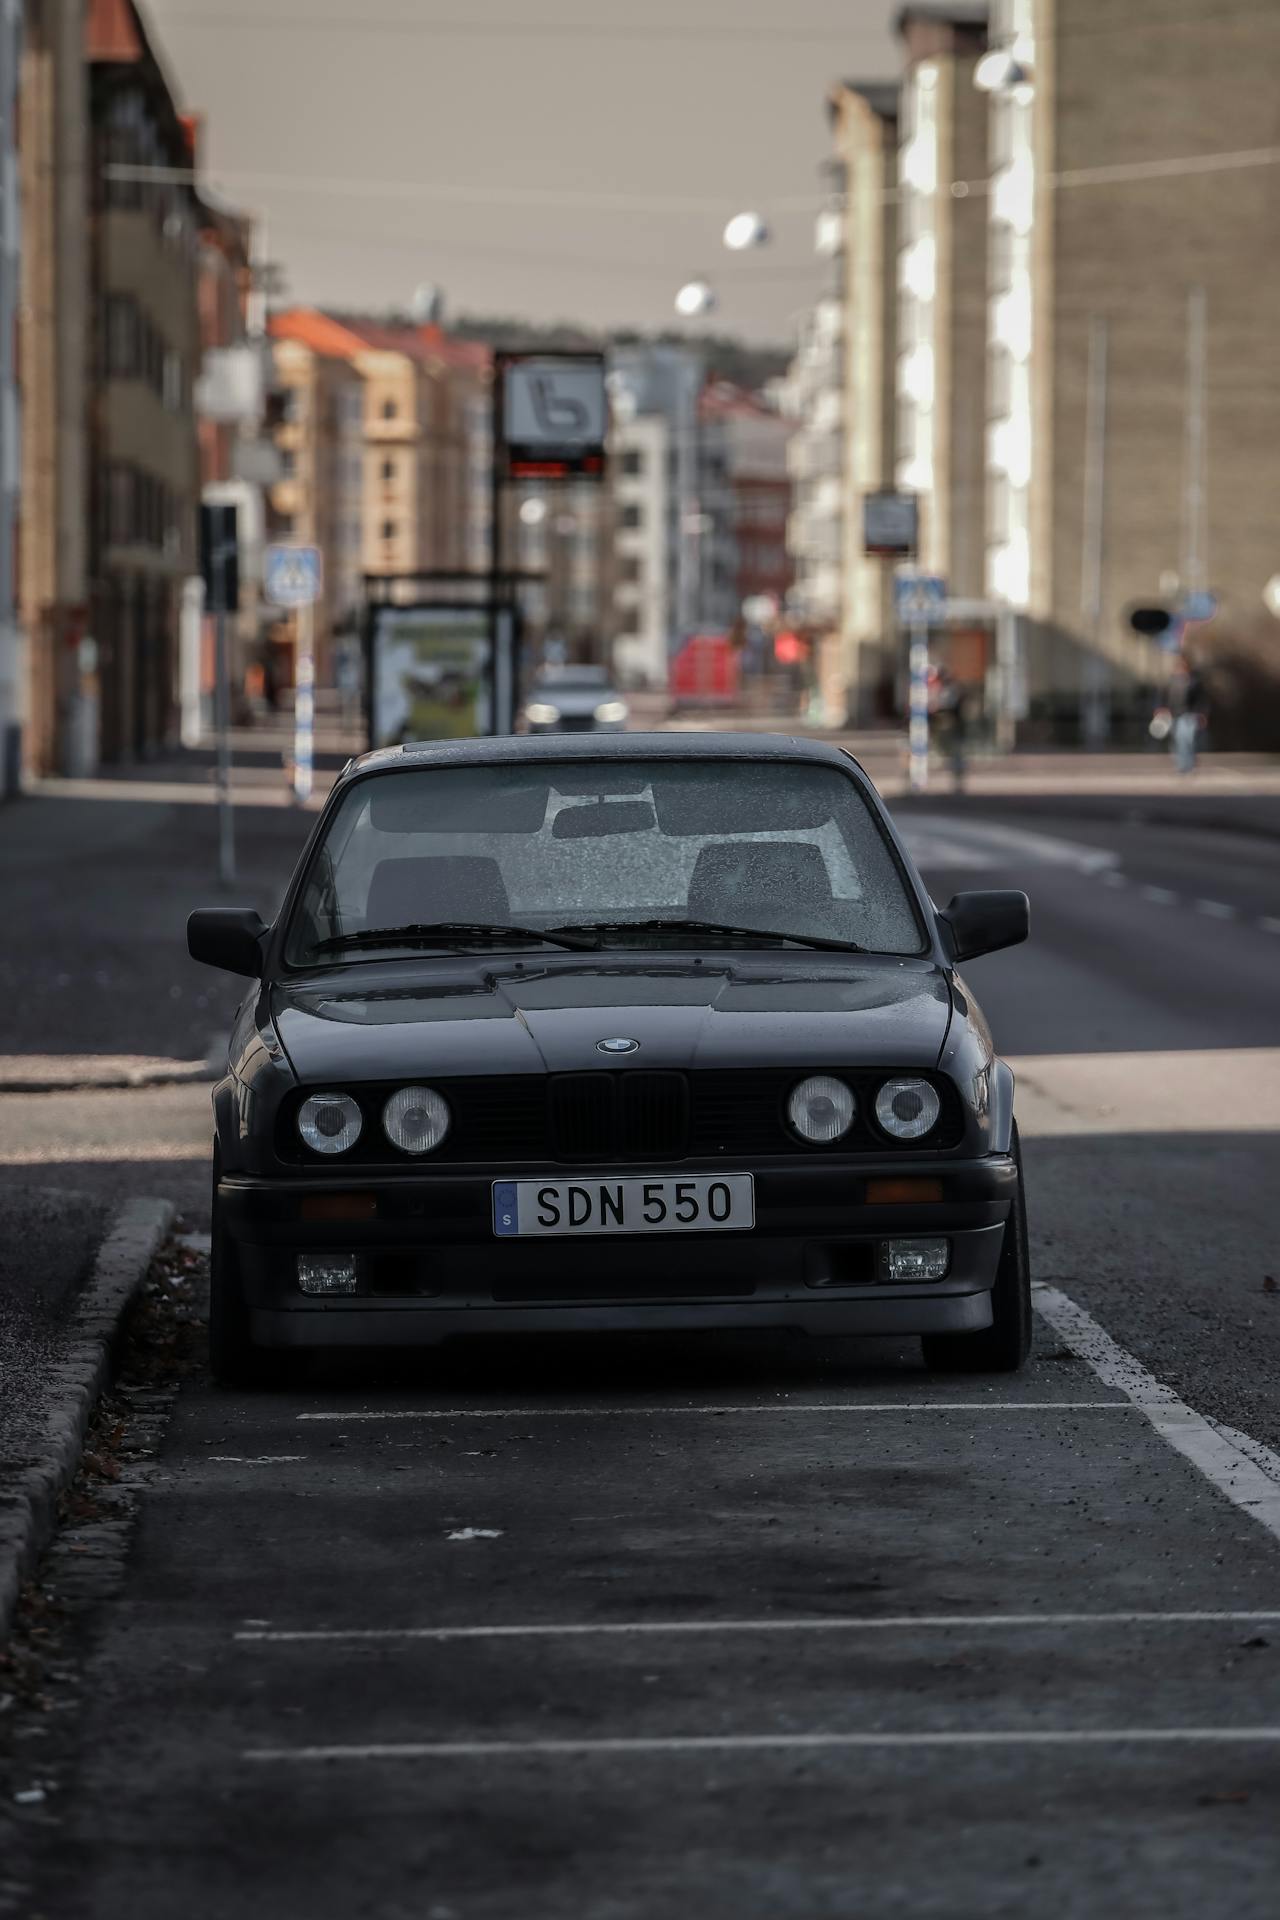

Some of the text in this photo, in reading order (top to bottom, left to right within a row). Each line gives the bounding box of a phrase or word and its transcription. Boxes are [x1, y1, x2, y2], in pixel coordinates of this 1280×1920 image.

[537, 1182, 731, 1227] SDN 550
[503, 1214, 511, 1226] S
